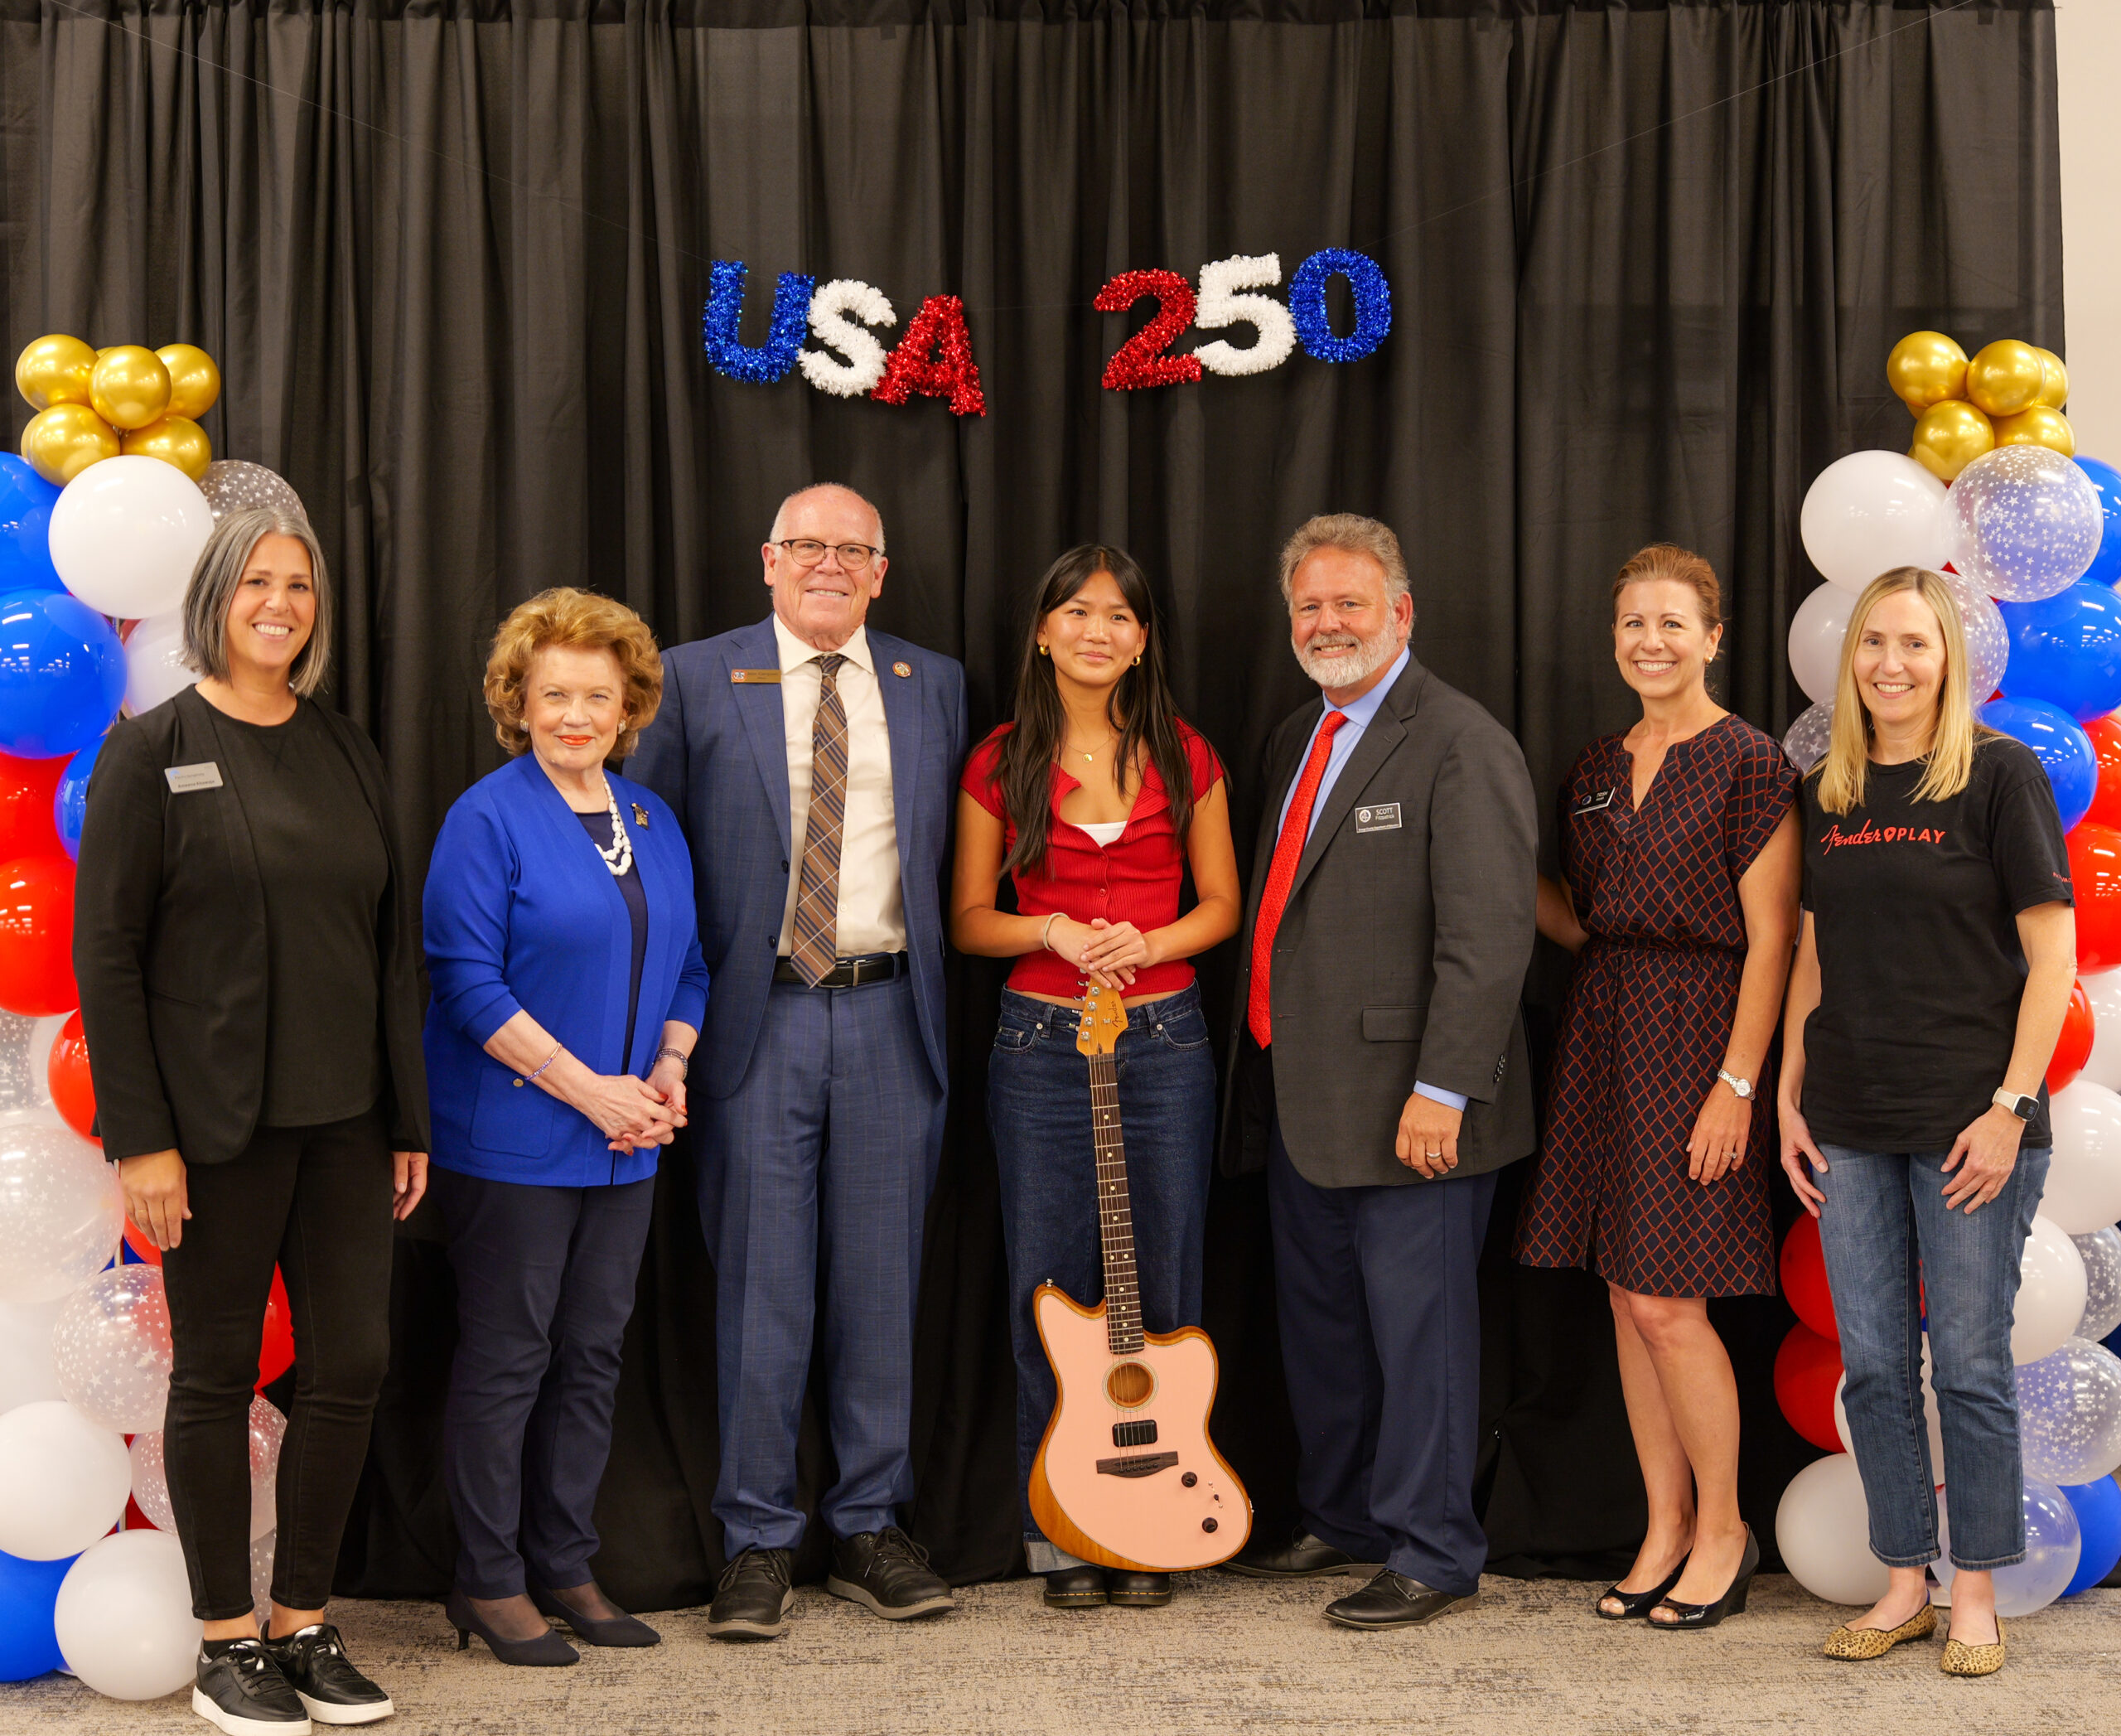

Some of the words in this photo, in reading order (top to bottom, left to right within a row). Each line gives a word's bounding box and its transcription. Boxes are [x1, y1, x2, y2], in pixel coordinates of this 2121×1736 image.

[703, 259, 987, 417] USA
[1093, 247, 1392, 391] 250
[1820, 819, 1882, 855] Fender
[1896, 827, 1946, 844] PLAY
